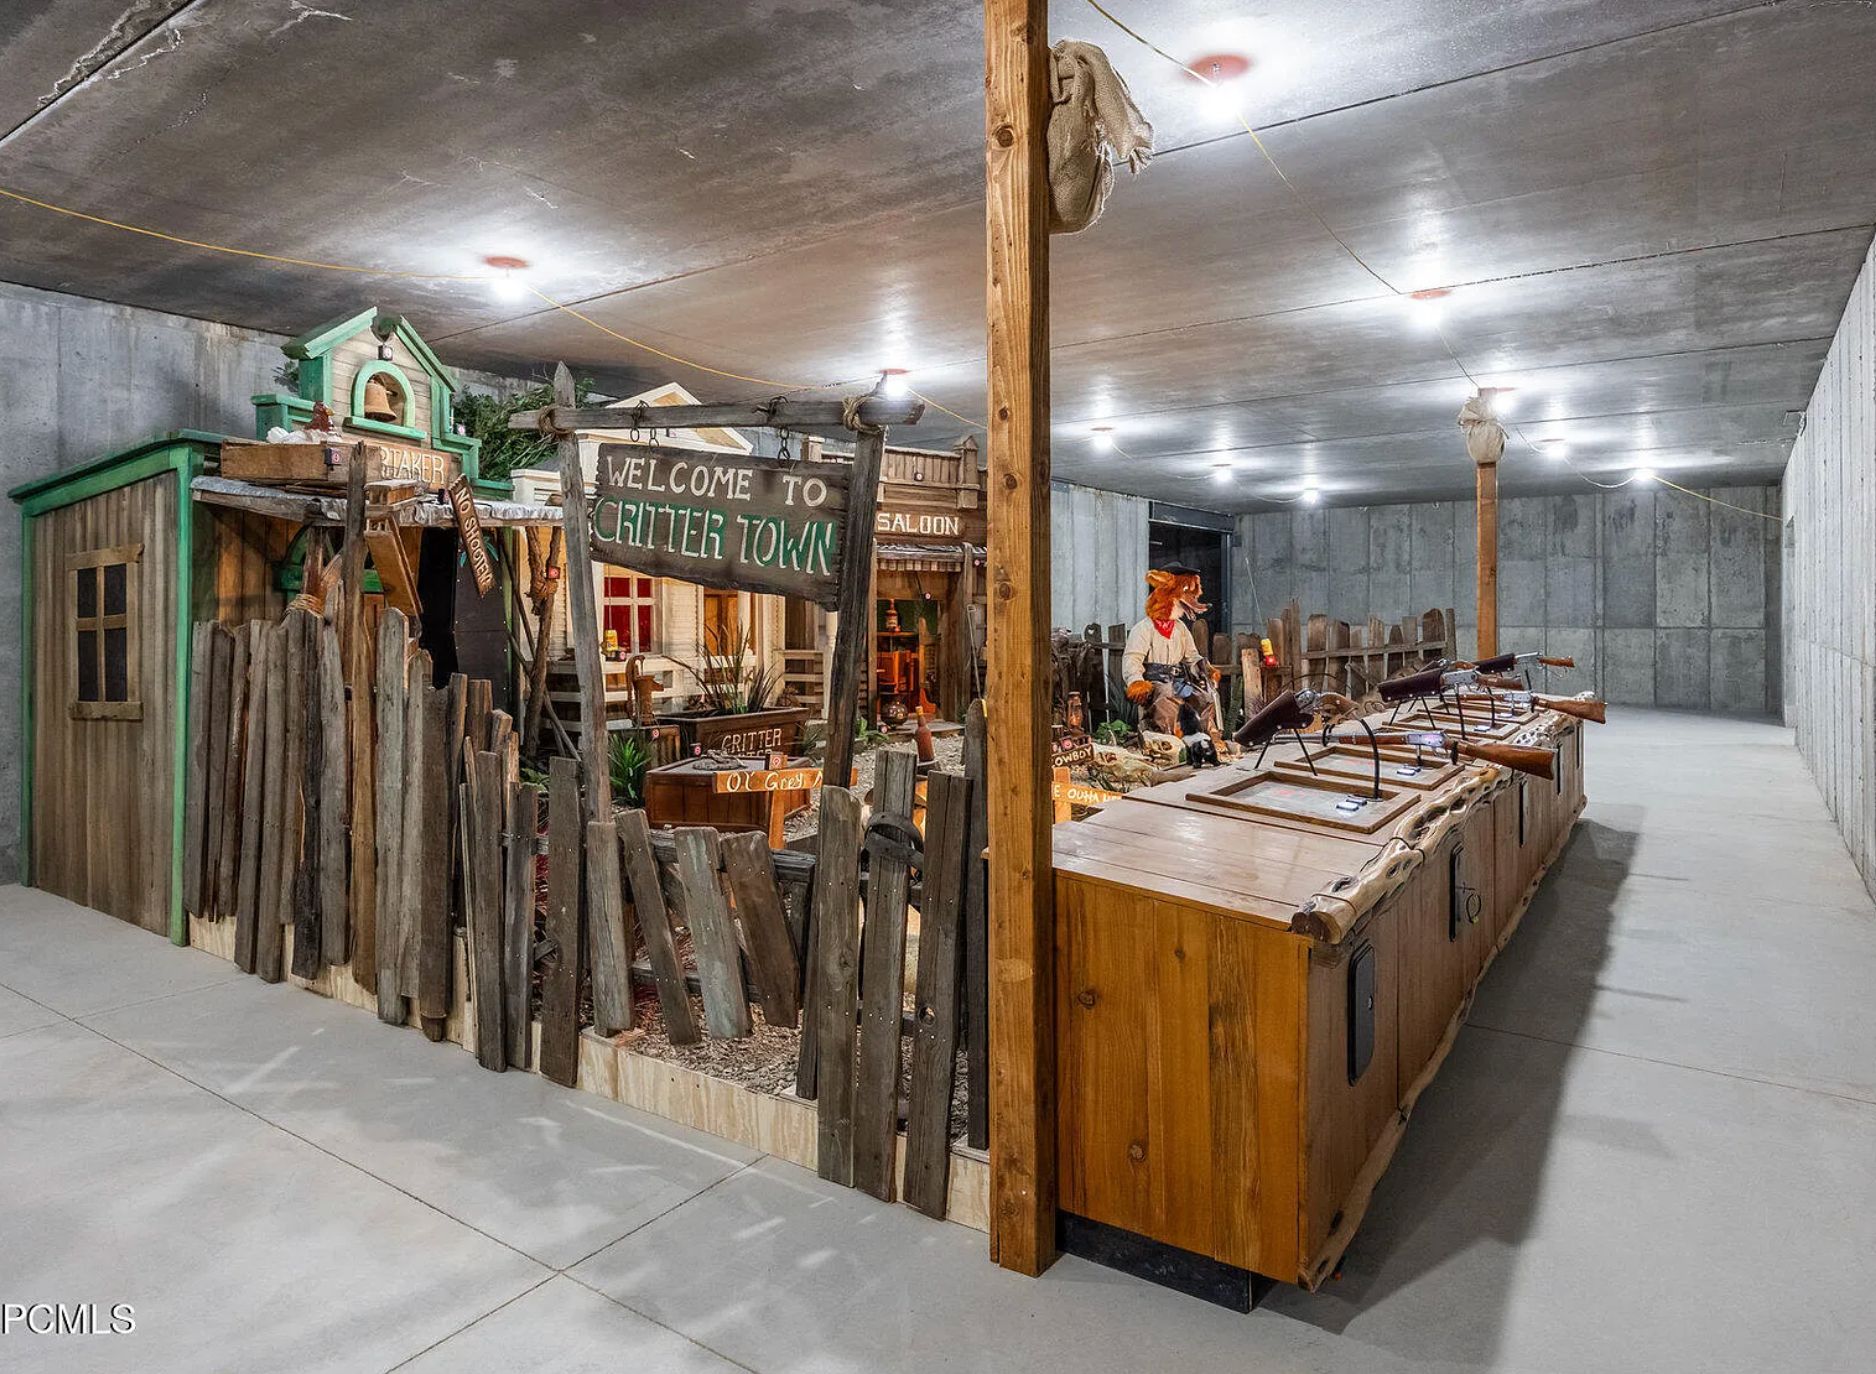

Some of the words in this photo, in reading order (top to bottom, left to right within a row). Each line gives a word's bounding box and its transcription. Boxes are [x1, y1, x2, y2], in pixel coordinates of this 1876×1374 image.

[379, 446, 445, 484] RTAKER
[606, 455, 754, 501] WELCOME
[782, 474, 828, 507] TO
[455, 487, 472, 514] NO
[592, 496, 727, 560] CRITTER
[736, 513, 839, 577] TOWN
[876, 512, 960, 536] SALOON
[720, 728, 783, 754] CRITTER
[1053, 746, 1093, 767] OWBOY
[764, 770, 805, 792] Grey
